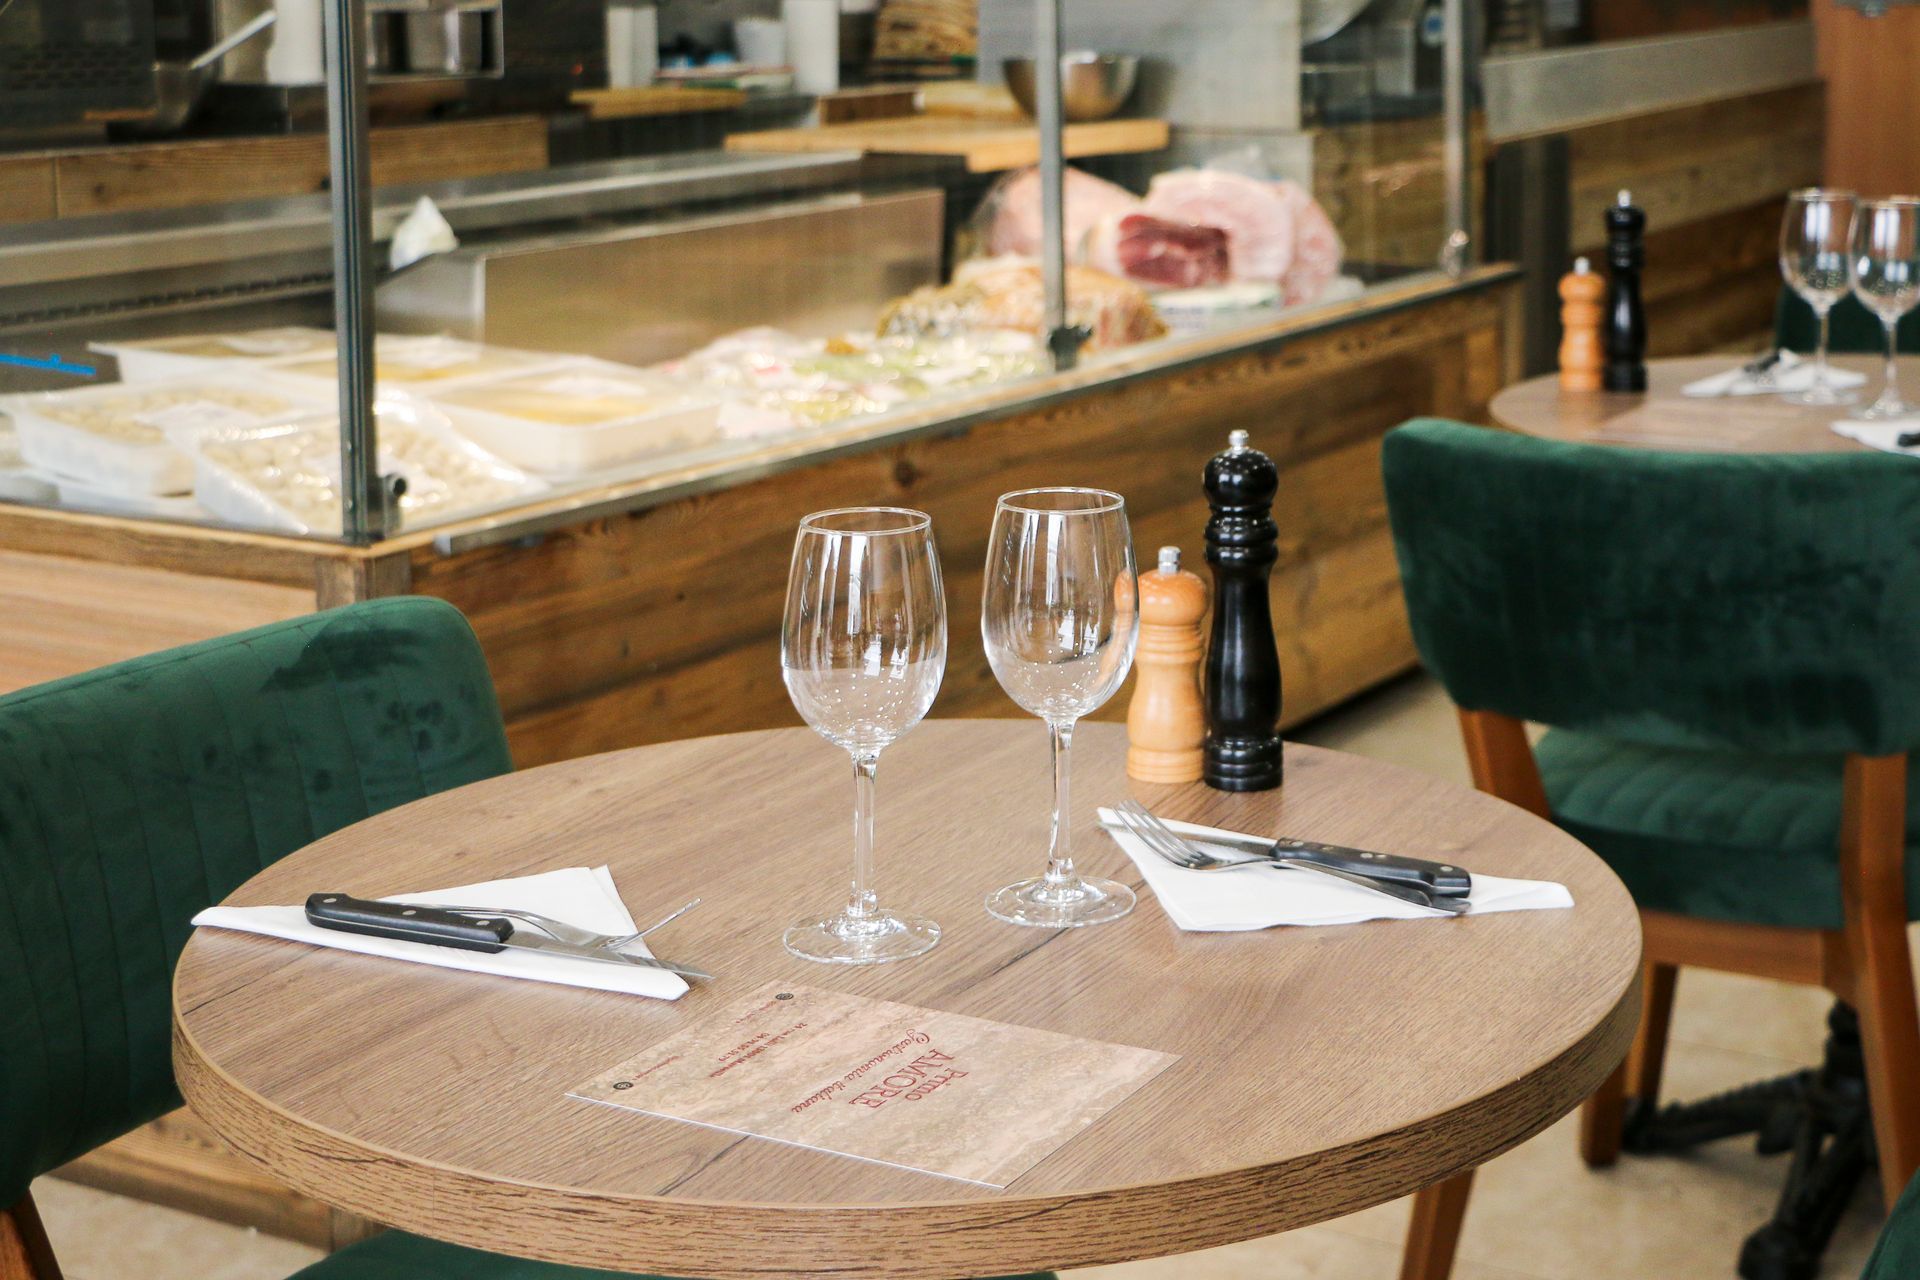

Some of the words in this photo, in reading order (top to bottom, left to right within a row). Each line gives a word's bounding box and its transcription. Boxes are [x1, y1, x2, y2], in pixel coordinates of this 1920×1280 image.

[848, 1049, 955, 1108] AMORE
[905, 1068, 969, 1101] Primo
[790, 1081, 846, 1113] italiana
